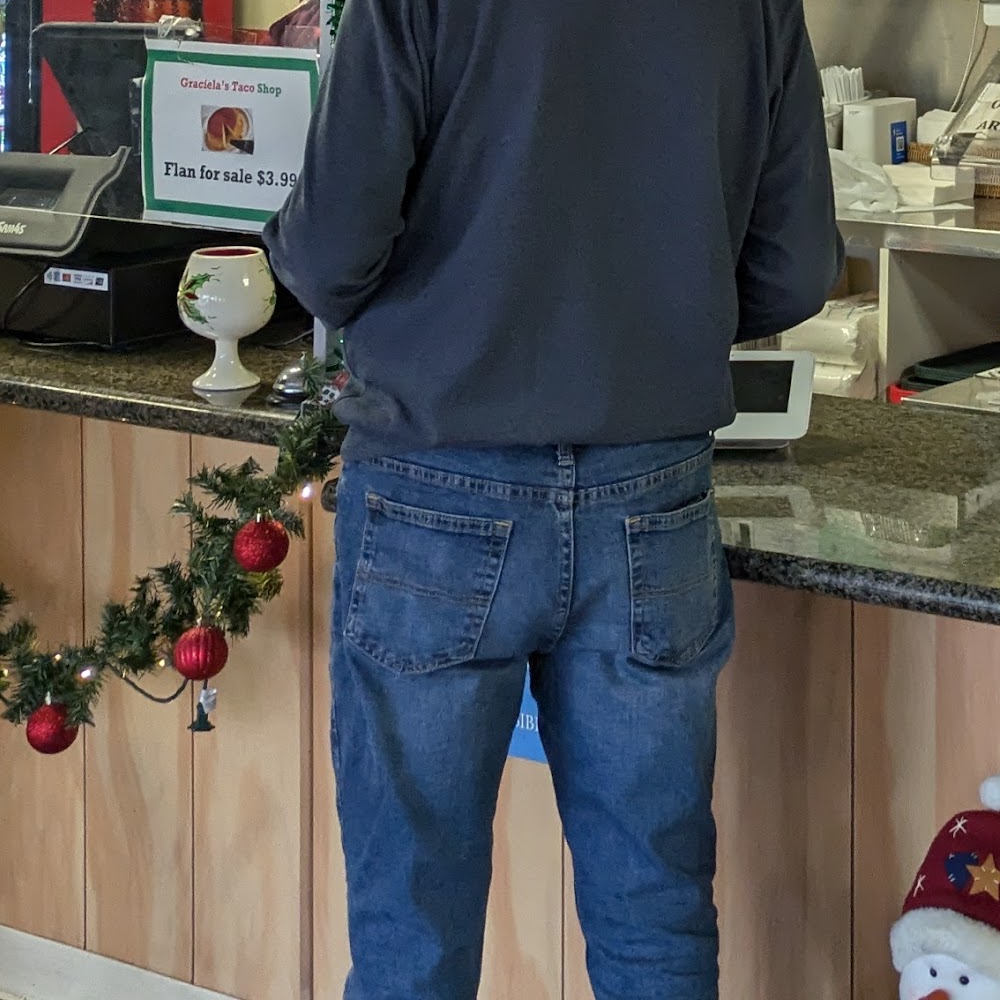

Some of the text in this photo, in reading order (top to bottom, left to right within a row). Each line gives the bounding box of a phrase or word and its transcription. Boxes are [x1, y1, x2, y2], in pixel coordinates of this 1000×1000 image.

[180, 78, 281, 97] Graciela's Taco Shop
[164, 162, 196, 178] Flan
[200, 165, 220, 180] for
[224, 169, 252, 183] sale
